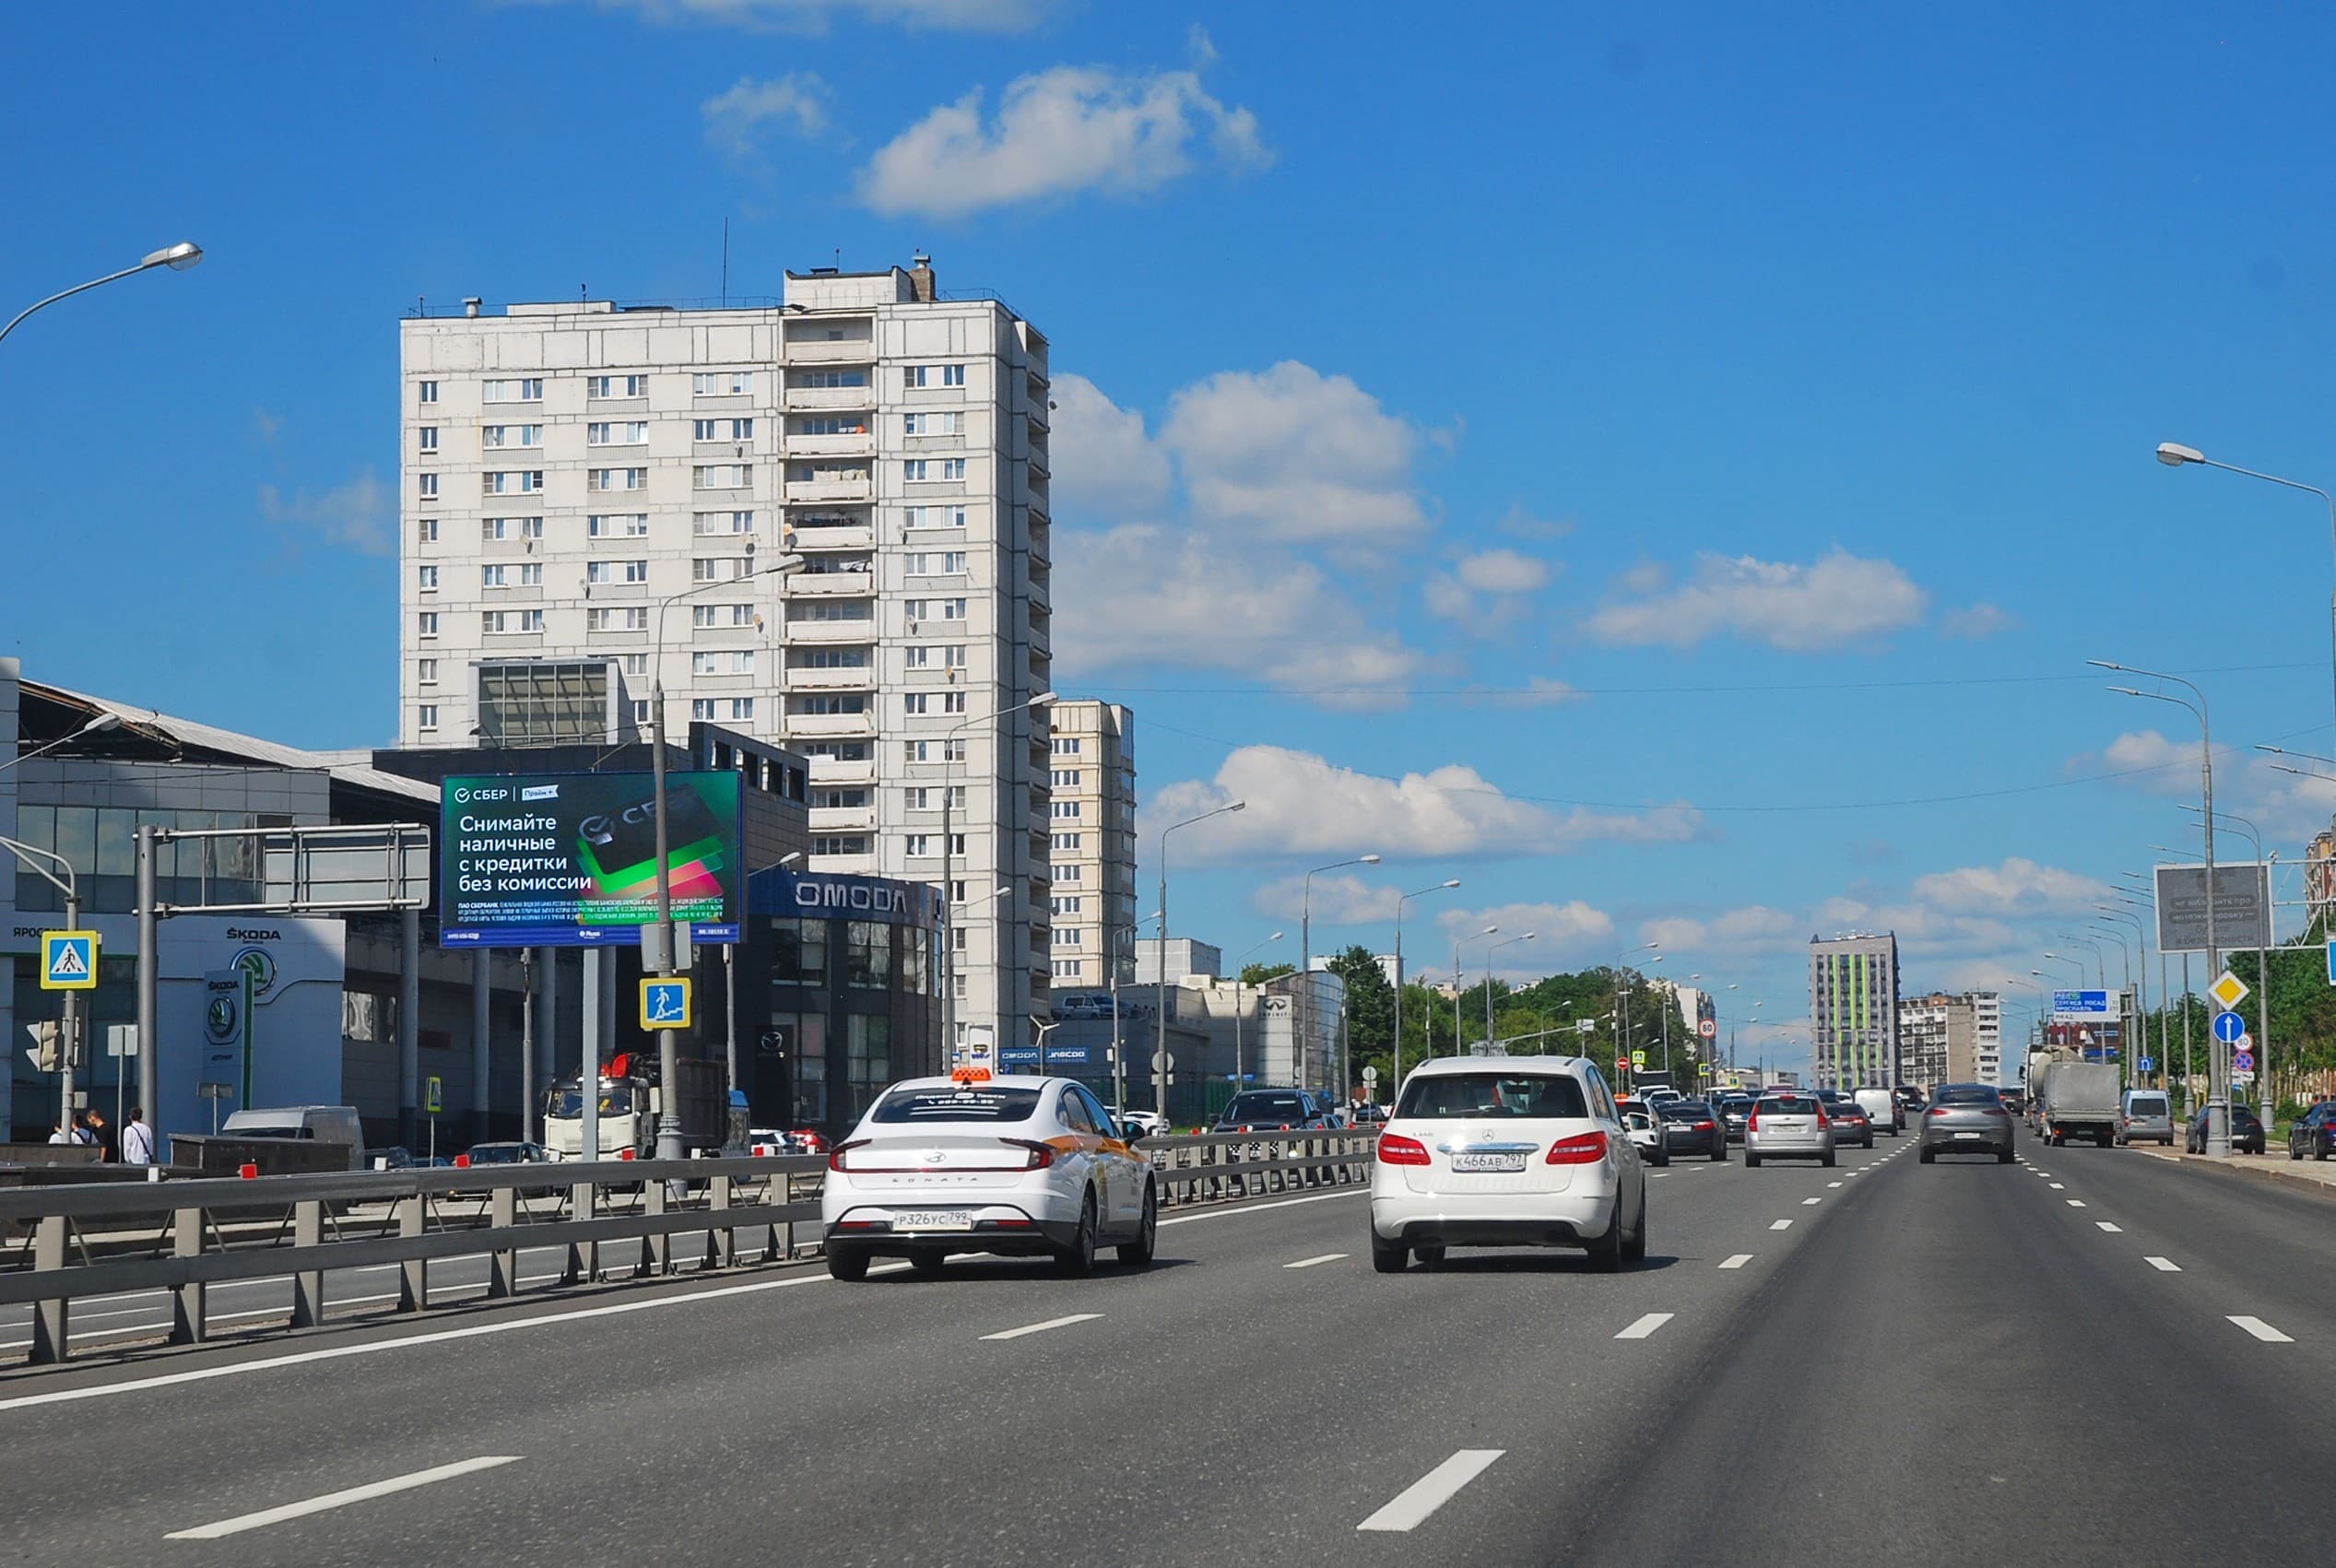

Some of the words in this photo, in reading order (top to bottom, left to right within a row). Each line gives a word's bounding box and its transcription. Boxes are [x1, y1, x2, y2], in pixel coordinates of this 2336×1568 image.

[473, 789, 508, 800] СБЕР
[460, 813, 557, 831] Снимайте
[460, 837, 556, 852] наличные
[459, 859, 470, 871] с
[475, 857, 568, 875] кредитки
[459, 875, 492, 891] без
[498, 877, 591, 890] комиссии
[796, 882, 907, 913] OMODA
[227, 927, 281, 940] ŠKODA
[208, 980, 239, 991] ŠKODA
